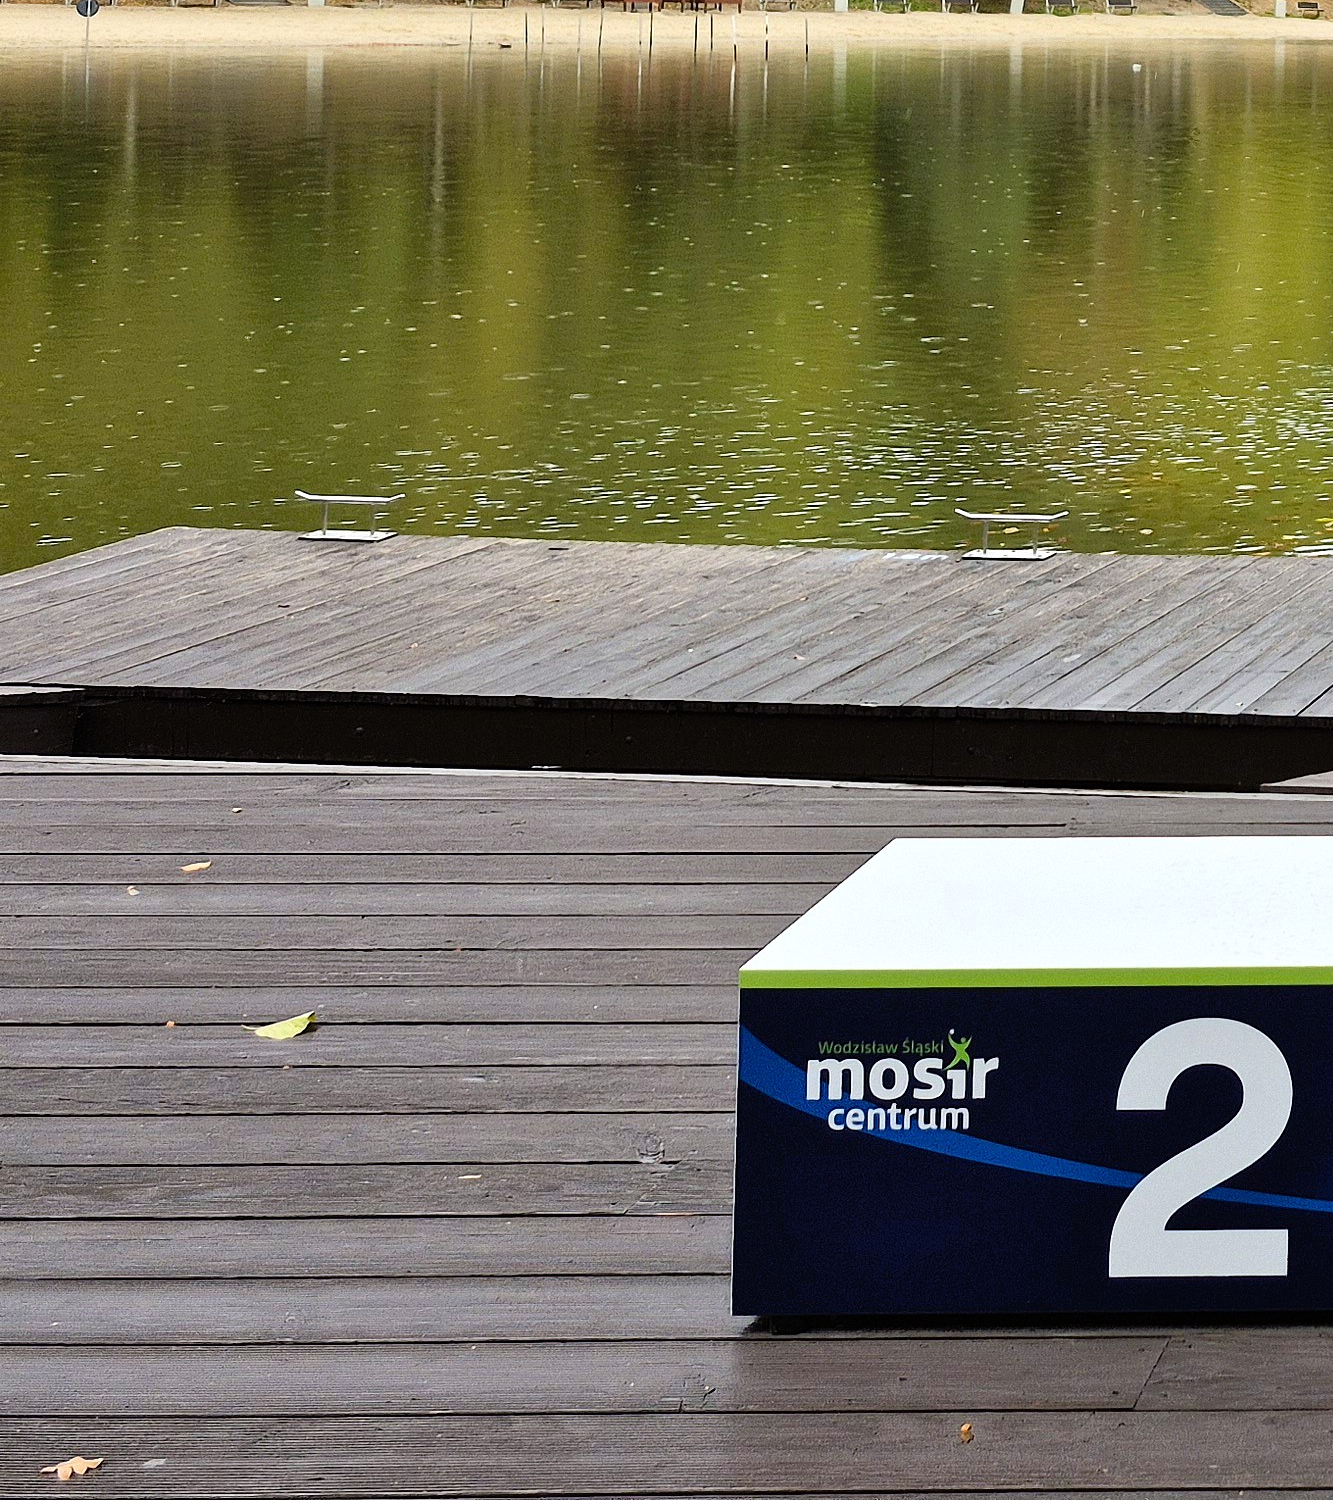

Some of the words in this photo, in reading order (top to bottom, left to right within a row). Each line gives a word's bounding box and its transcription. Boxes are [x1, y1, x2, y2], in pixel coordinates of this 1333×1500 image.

[818, 1040, 899, 1054] Wodzisław
[902, 1037, 944, 1057] Śląski
[806, 1057, 1000, 1100] mosir
[827, 1102, 970, 1131] centrum
[1109, 1017, 1293, 1278] 2
